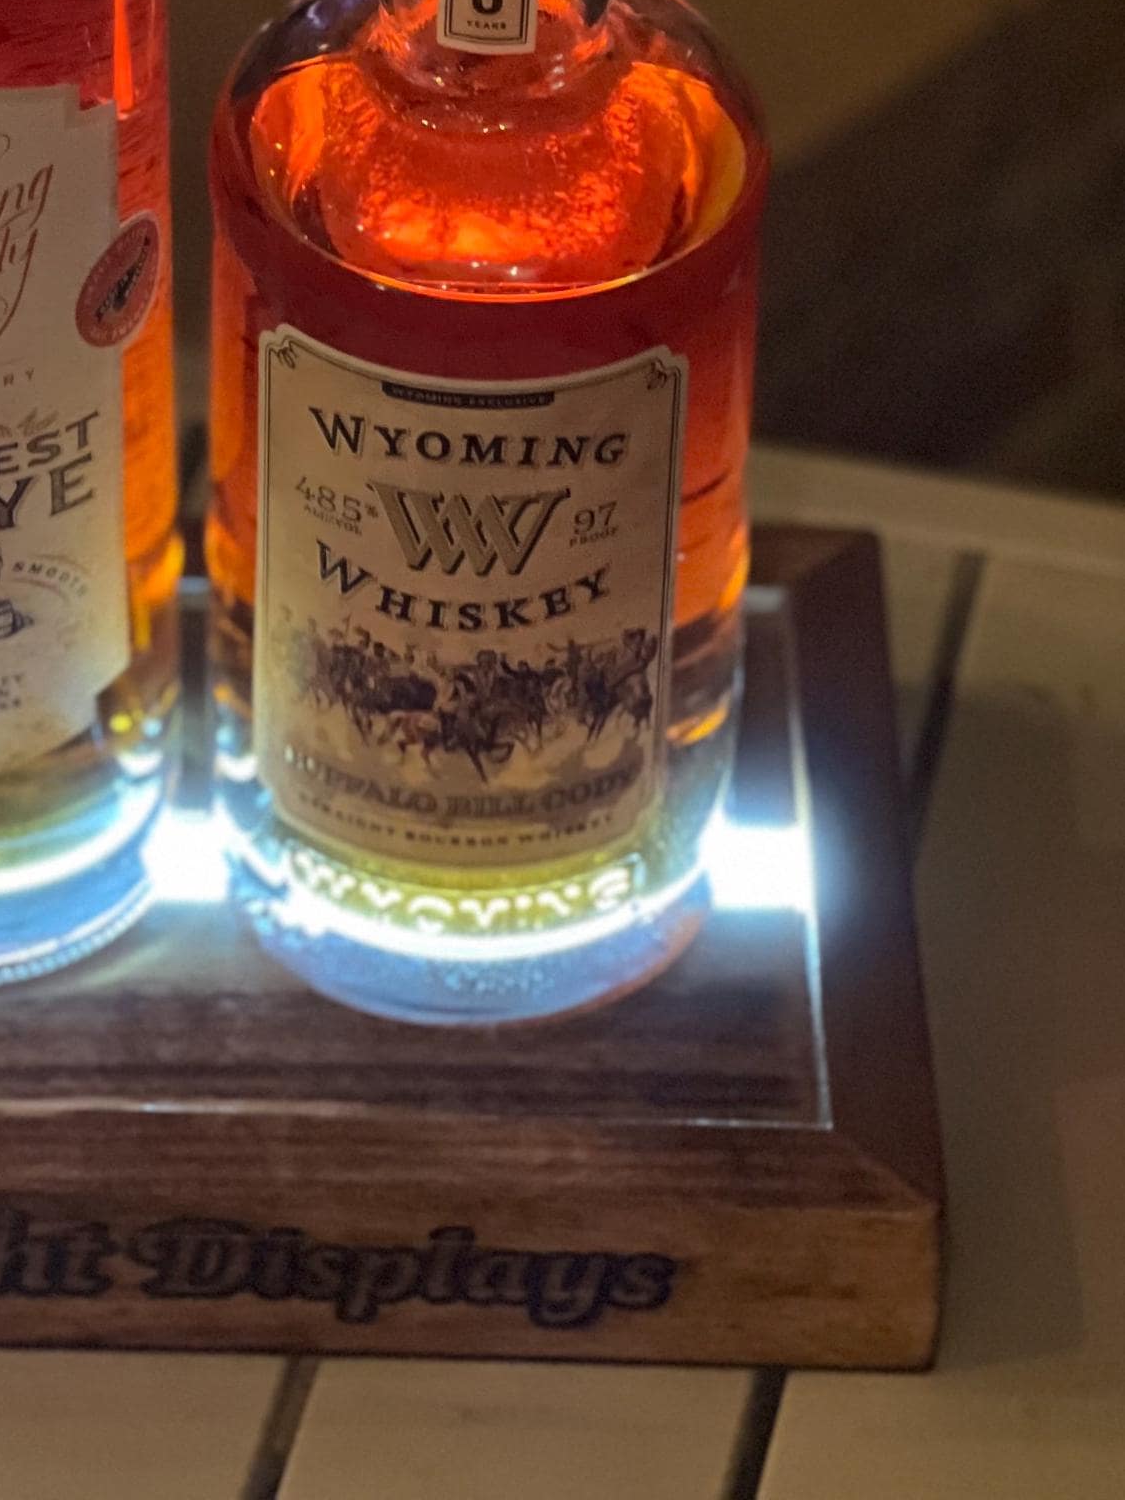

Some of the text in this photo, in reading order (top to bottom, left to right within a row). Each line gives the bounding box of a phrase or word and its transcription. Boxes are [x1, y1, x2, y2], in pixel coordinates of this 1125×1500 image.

[466, 19, 507, 31] YEARS
[309, 405, 628, 466] WYOMING
[574, 500, 618, 535] 97
[569, 524, 620, 548] PROOF
[12, 561, 89, 597] SMOOTH
[316, 539, 613, 632] WHISKEY
[405, 832, 509, 847] BOURBON
[127, 1217, 677, 1330] Displays
